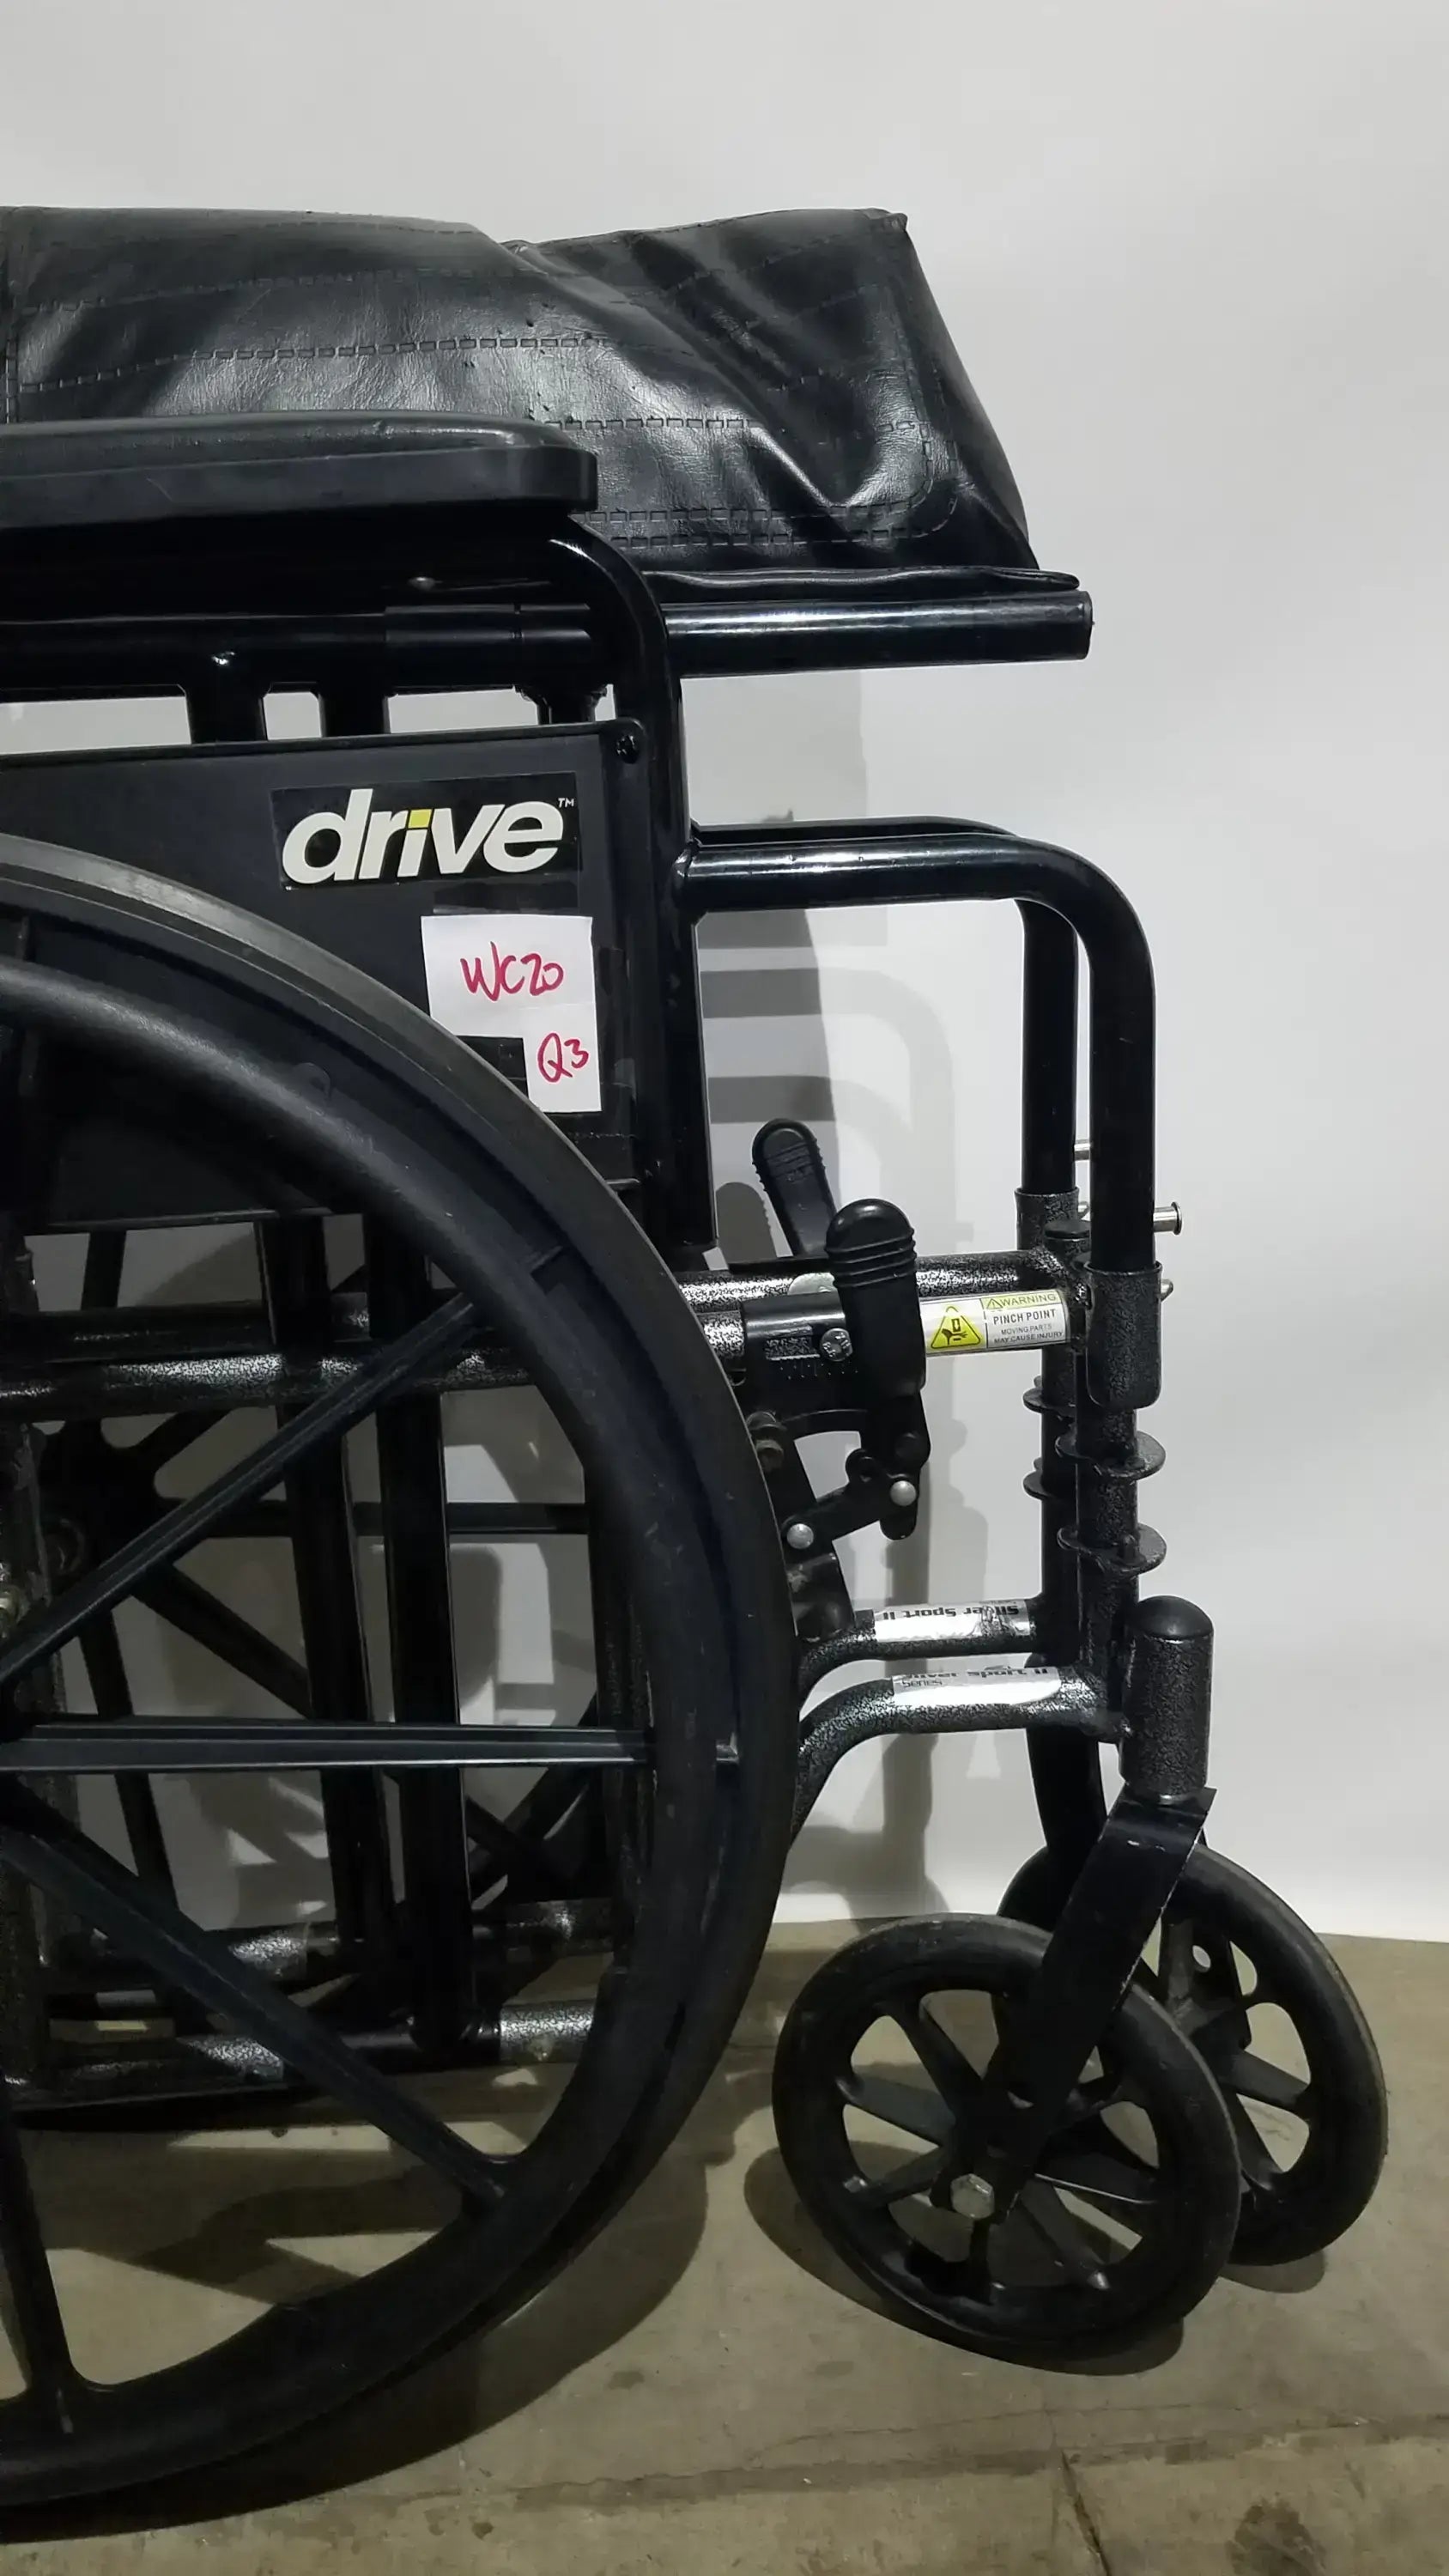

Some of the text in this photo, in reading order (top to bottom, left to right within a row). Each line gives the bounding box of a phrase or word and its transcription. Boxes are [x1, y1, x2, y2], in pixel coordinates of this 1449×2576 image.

[282, 788, 564, 884] drive
[460, 941, 564, 1001] WC20
[537, 1032, 590, 1083] Q3
[1000, 1294, 1056, 1306] WARNING
[993, 1309, 1056, 1325] PINCH POINT
[1001, 1323, 1052, 1335] MOVING PARTS
[1010, 1334, 1035, 1342] CAUSE
[1037, 1331, 1063, 1340] INJURY
[902, 1607, 957, 1619] Sport
[963, 1605, 1019, 1616] Siler
